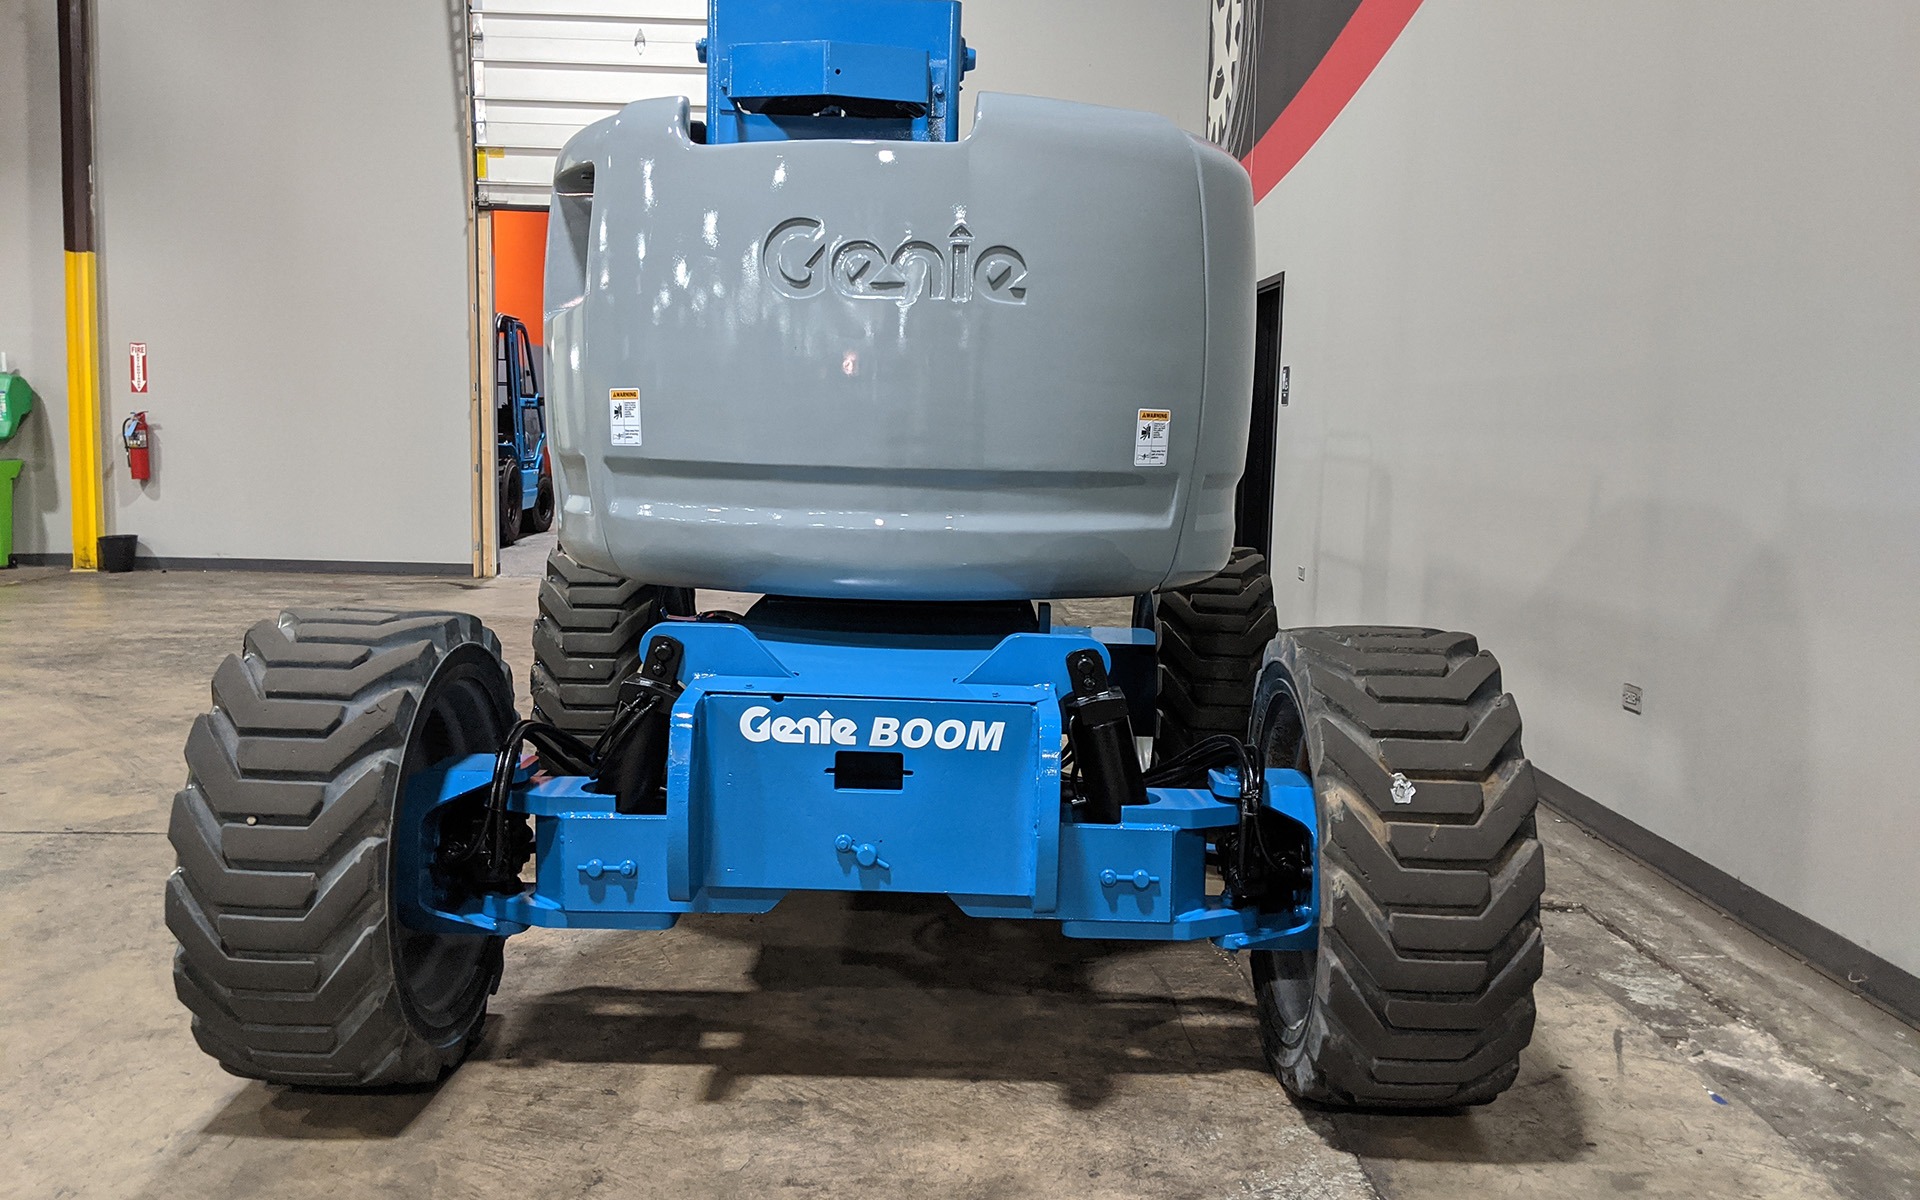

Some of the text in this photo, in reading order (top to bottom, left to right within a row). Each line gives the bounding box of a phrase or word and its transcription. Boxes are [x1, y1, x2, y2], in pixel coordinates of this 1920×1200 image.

[763, 216, 1028, 306] Genie
[739, 705, 1006, 751] Genie BOOM
